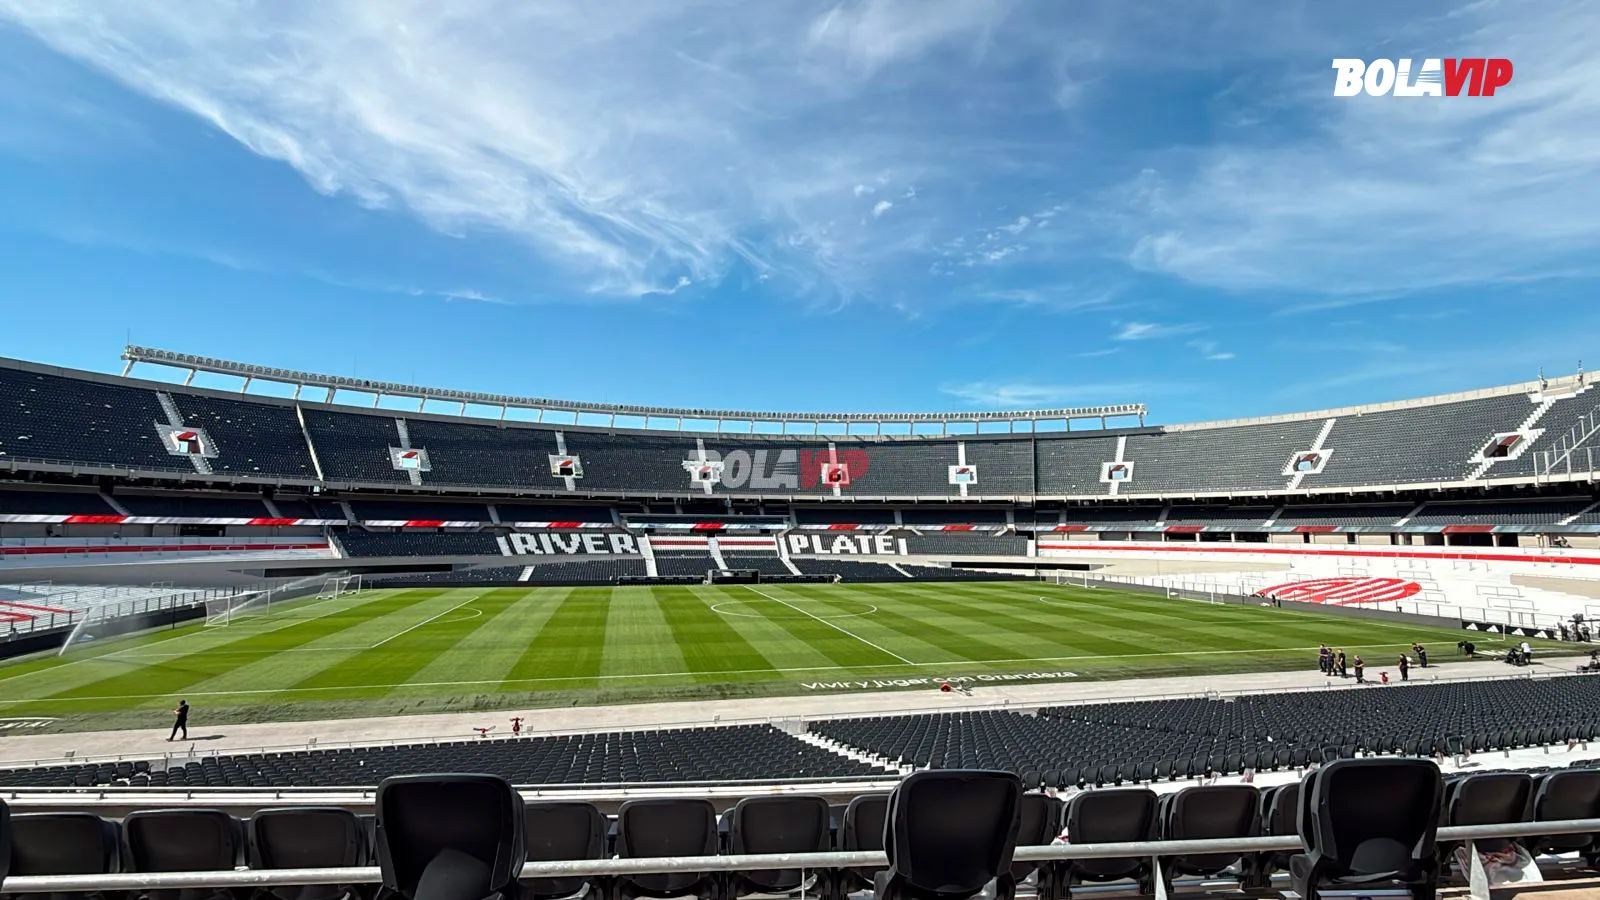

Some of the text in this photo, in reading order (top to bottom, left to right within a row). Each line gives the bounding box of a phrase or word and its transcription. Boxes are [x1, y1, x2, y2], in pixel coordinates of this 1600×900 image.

[509, 533, 896, 555] RIVER PLATE
[854, 680, 868, 689] y
